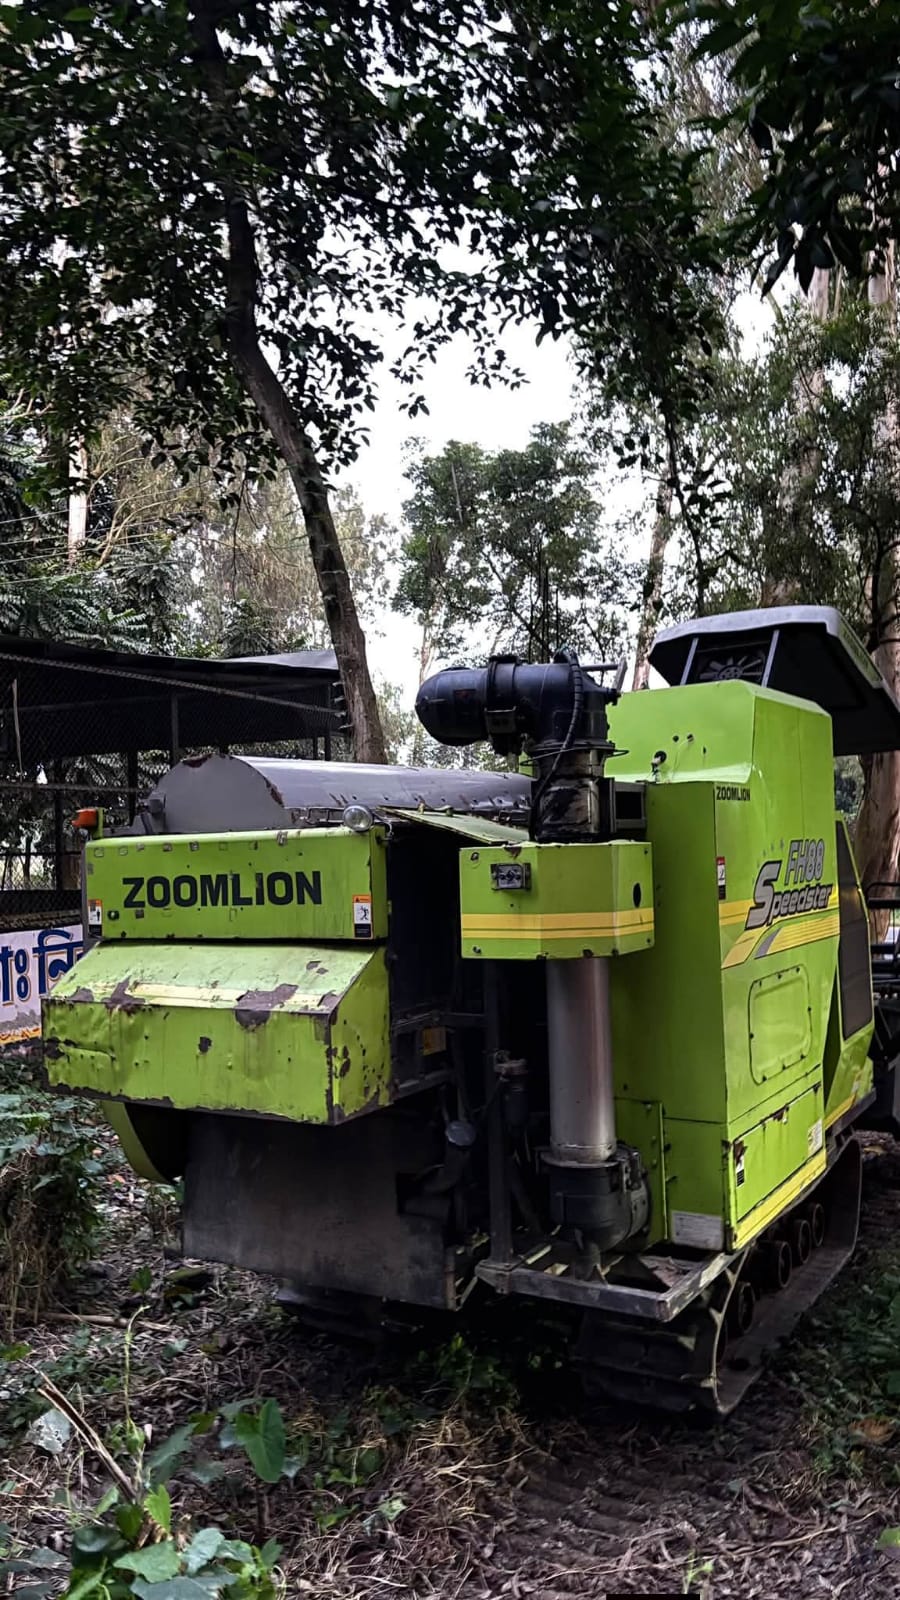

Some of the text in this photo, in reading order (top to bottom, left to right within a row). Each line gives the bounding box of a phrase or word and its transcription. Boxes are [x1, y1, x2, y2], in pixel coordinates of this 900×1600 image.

[715, 786, 750, 801] ZOOMLION
[784, 839, 826, 886] FH88
[122, 871, 322, 909] ZOOMLION
[744, 860, 833, 931] Speedster
